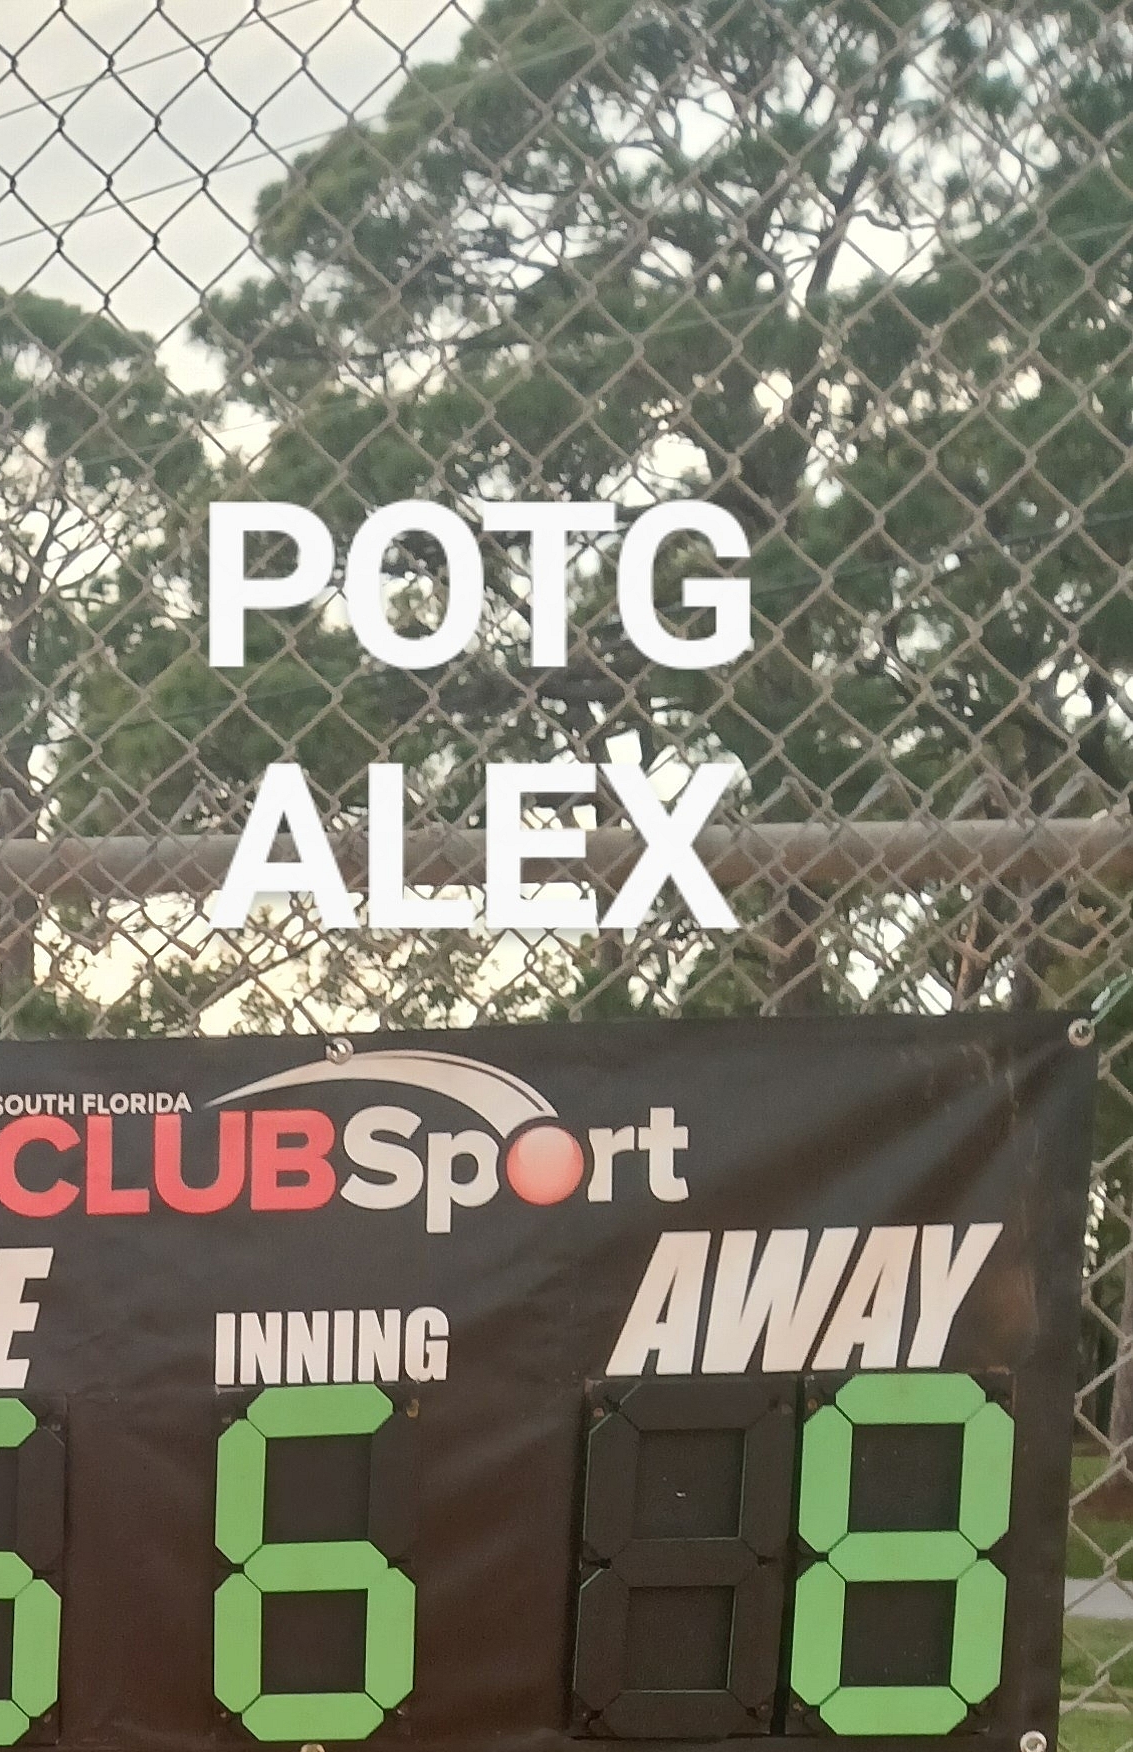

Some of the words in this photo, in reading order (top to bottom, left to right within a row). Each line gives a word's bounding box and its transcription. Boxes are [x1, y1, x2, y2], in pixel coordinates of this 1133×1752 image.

[82, 1091, 193, 1115] FLORIDA
[213, 1306, 450, 1386] INNING
[603, 1222, 1004, 1378] AWAY
[212, 1383, 417, 1743] 6
[789, 1372, 1015, 1737] 8
